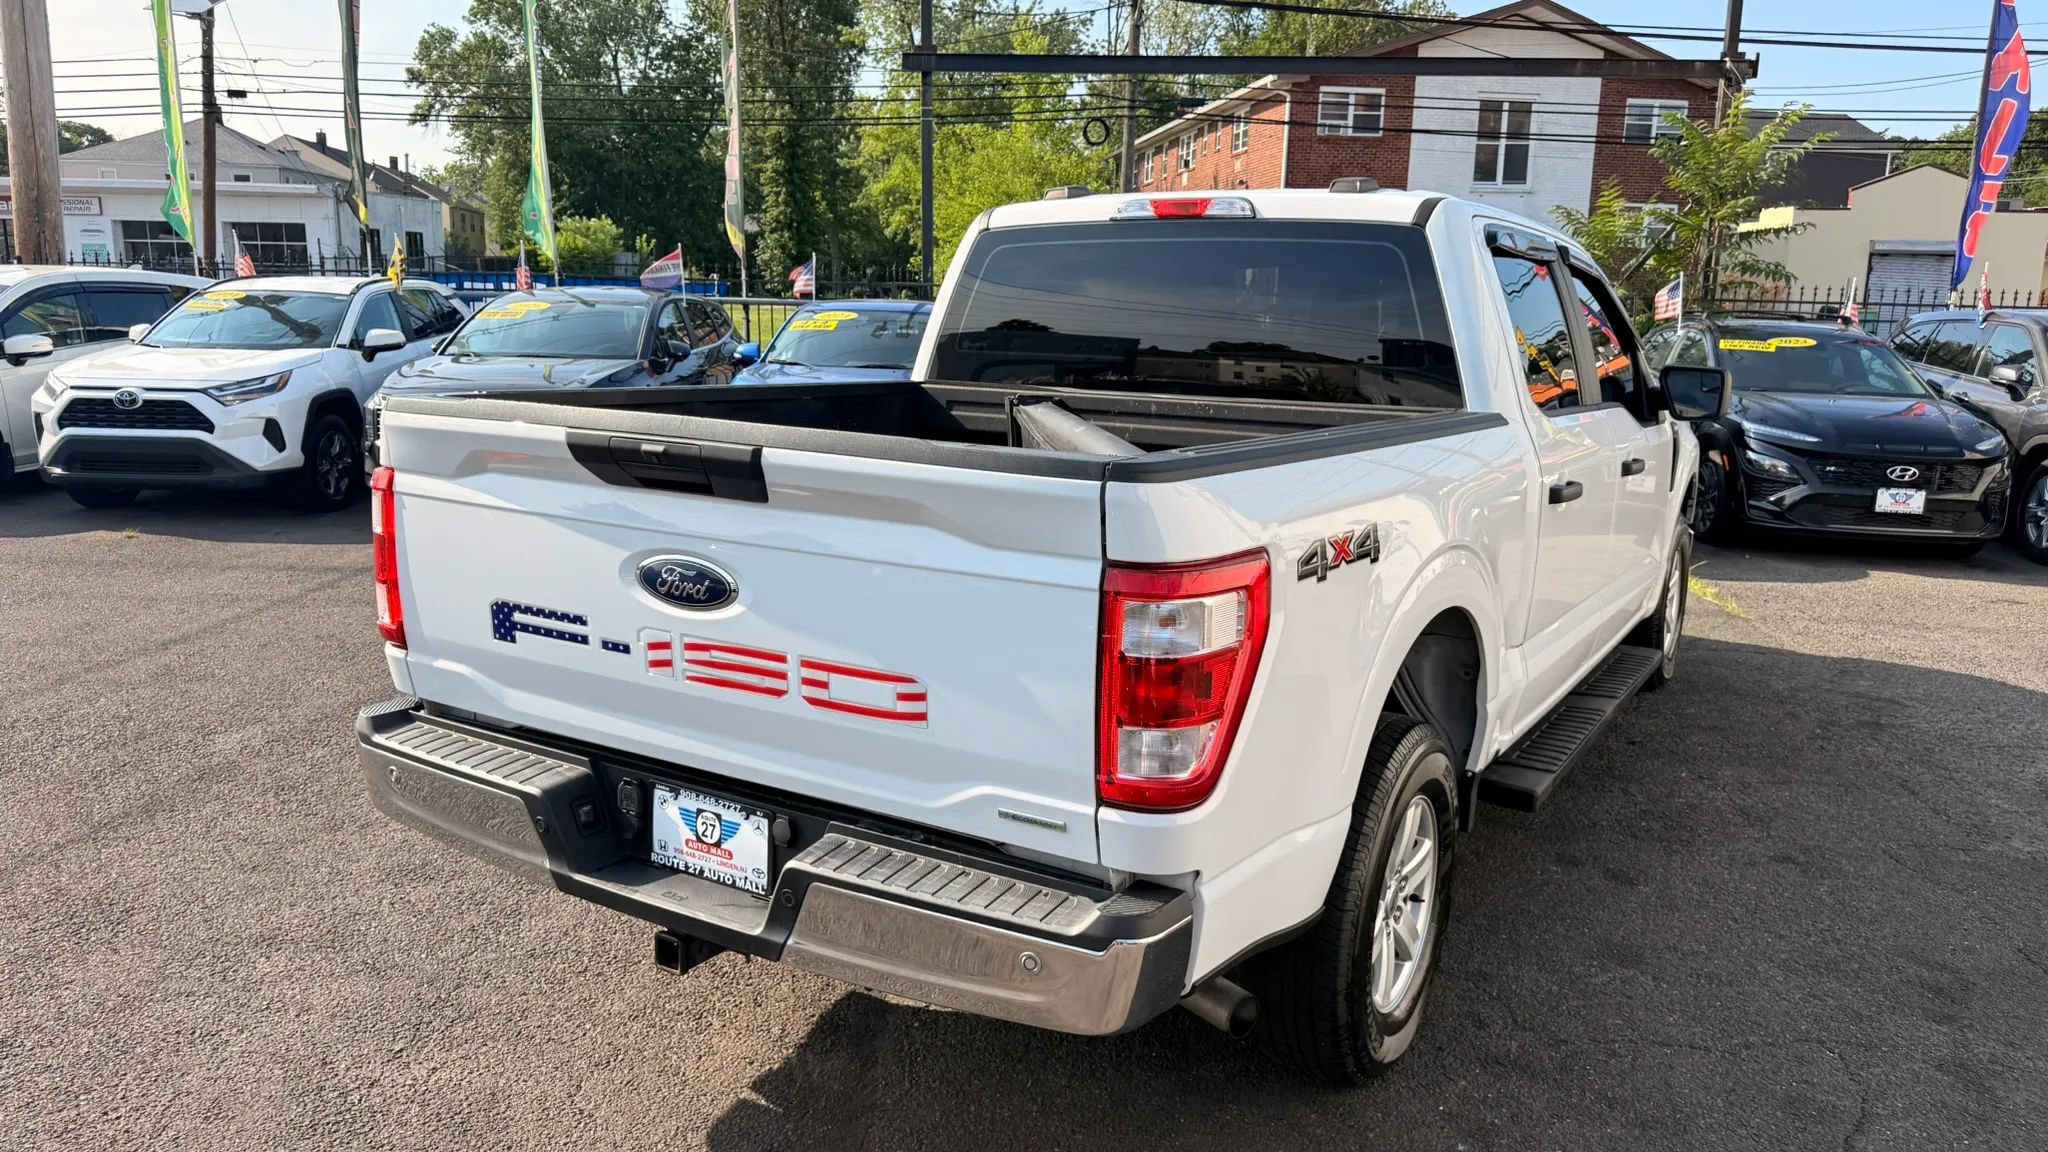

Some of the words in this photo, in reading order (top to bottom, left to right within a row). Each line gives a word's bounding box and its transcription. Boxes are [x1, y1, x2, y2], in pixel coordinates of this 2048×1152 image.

[656, 565, 710, 600] Ford
[489, 598, 929, 729] F-150
[680, 789, 742, 813] 908-648-2727
[700, 821, 717, 840] 27
[701, 814, 717, 823] ROUTE
[687, 842, 708, 853] AUTO
[710, 846, 731, 858] MALL
[650, 852, 686, 872] ROUTE
[687, 863, 701, 875] 27
[703, 866, 733, 885] AUTO
[735, 877, 766, 895] MALL
